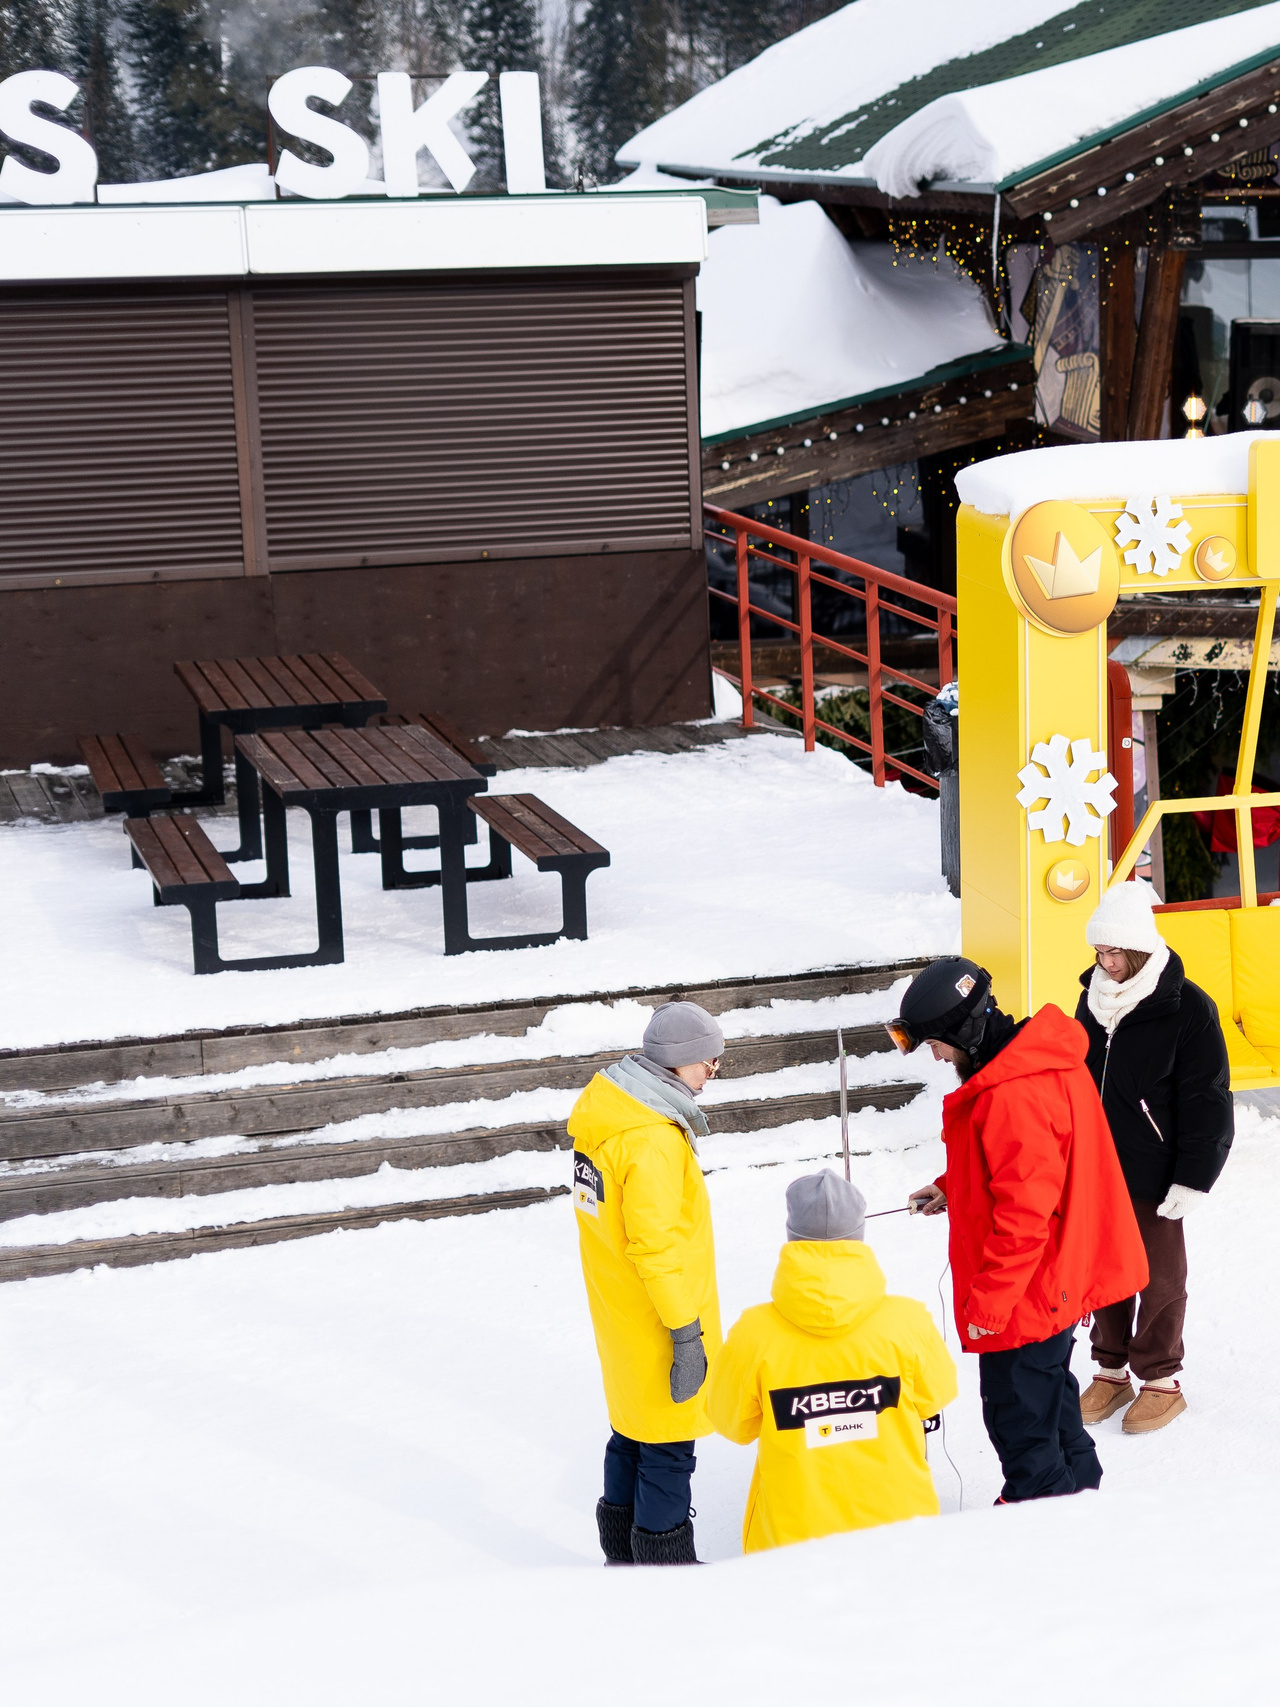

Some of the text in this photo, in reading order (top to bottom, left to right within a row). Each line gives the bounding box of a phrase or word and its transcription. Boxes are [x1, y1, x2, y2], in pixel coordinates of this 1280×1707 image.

[267, 66, 547, 200] SKI
[791, 1385, 882, 1416] КВЕСТ
[834, 1422, 864, 1432] БАНК
